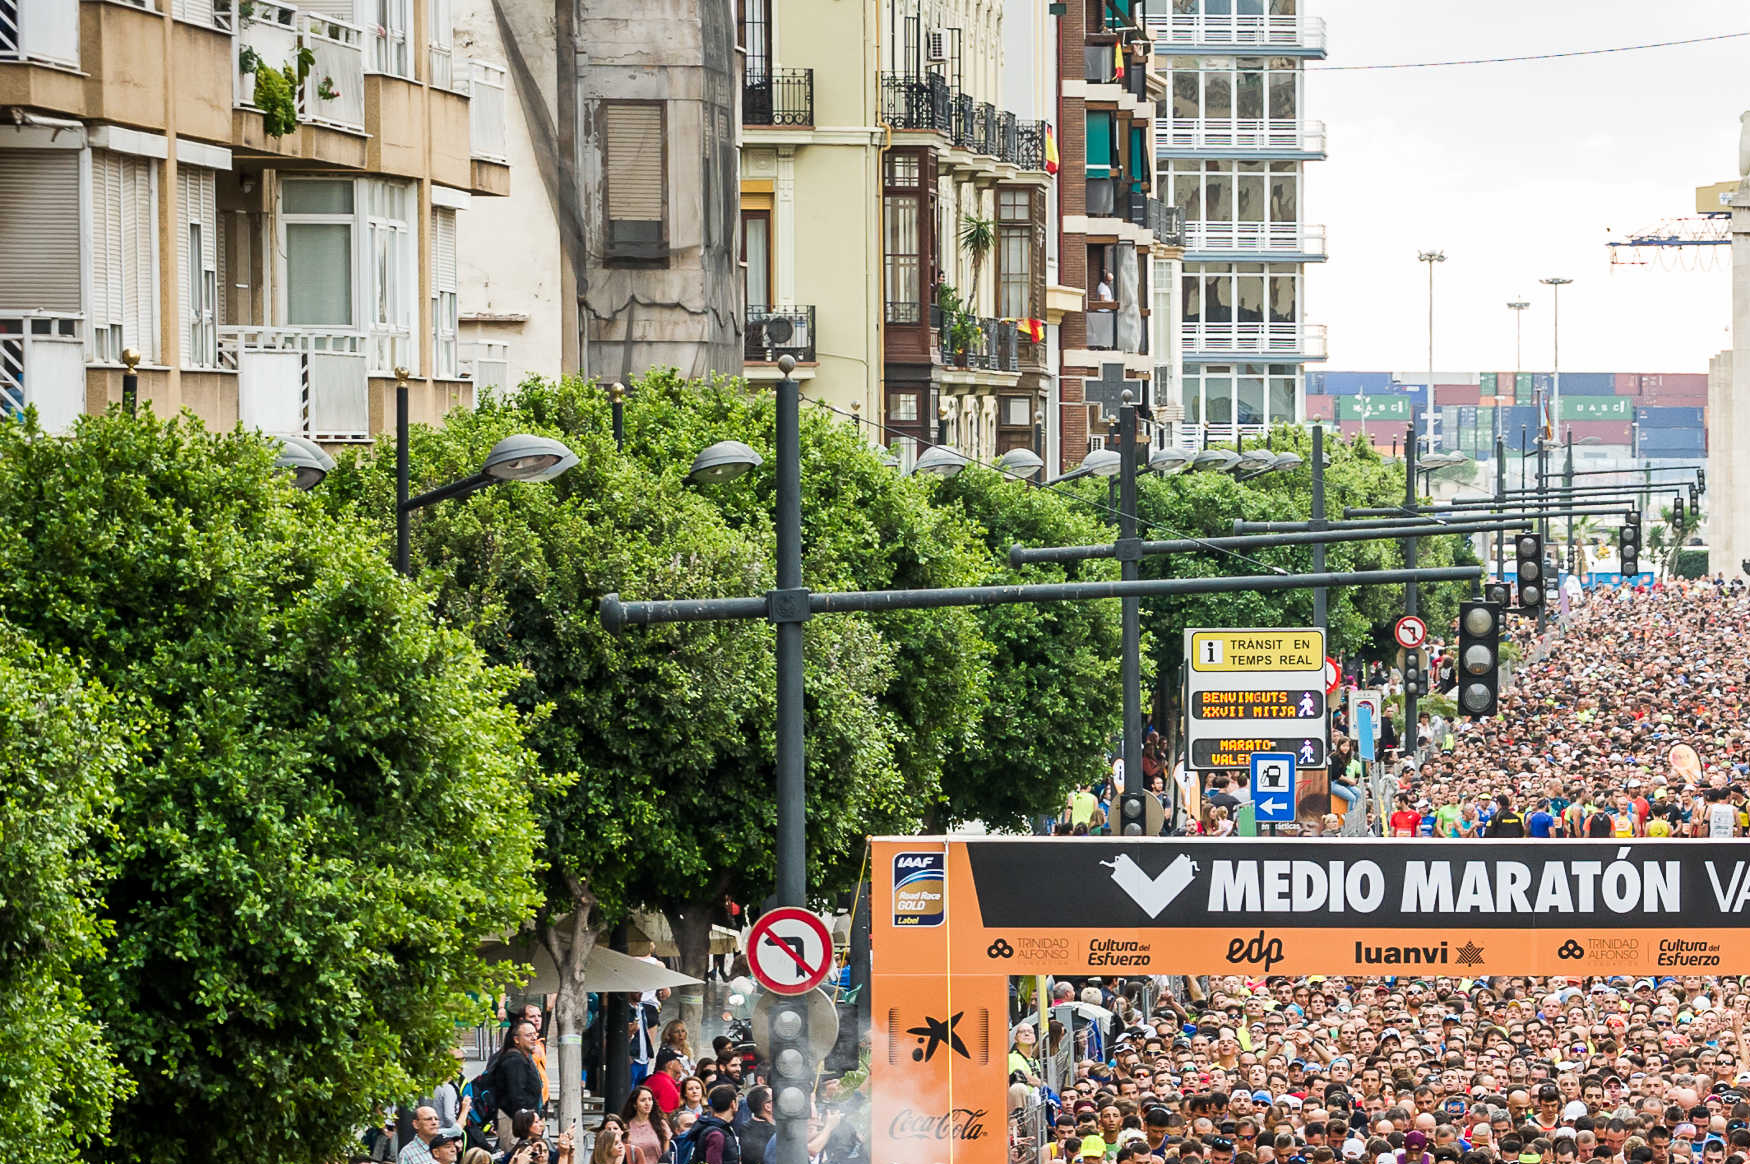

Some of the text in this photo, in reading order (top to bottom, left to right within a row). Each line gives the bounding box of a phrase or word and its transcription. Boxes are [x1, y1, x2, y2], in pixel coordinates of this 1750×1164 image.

[1294, 639, 1310, 649] EN
[1231, 655, 1313, 665] TEMPS REAL
[1202, 691, 1288, 703] BENVINGUTS
[1202, 706, 1296, 717] XXVII MITJA
[897, 856, 934, 868] IAAF
[1208, 859, 1385, 913] MEDIO
[1400, 846, 1681, 914] MARATÓN
[898, 890, 942, 901] Road Race
[897, 900, 926, 911] GOLD
[897, 915, 919, 925] Label
[1017, 938, 1069, 948] TRINIDAD
[1089, 938, 1139, 951] Cultura
[1588, 938, 1639, 949] TRINIDAD
[1659, 939, 1720, 952] Cultura del
[1017, 949, 1069, 960] ALFONSO
[1225, 930, 1285, 972] edp
[1355, 940, 1448, 965] luanvi
[1588, 949, 1639, 960] ALFONSO
[1088, 952, 1151, 966] Esfuerzo
[1657, 952, 1721, 966] Esfuerzo
